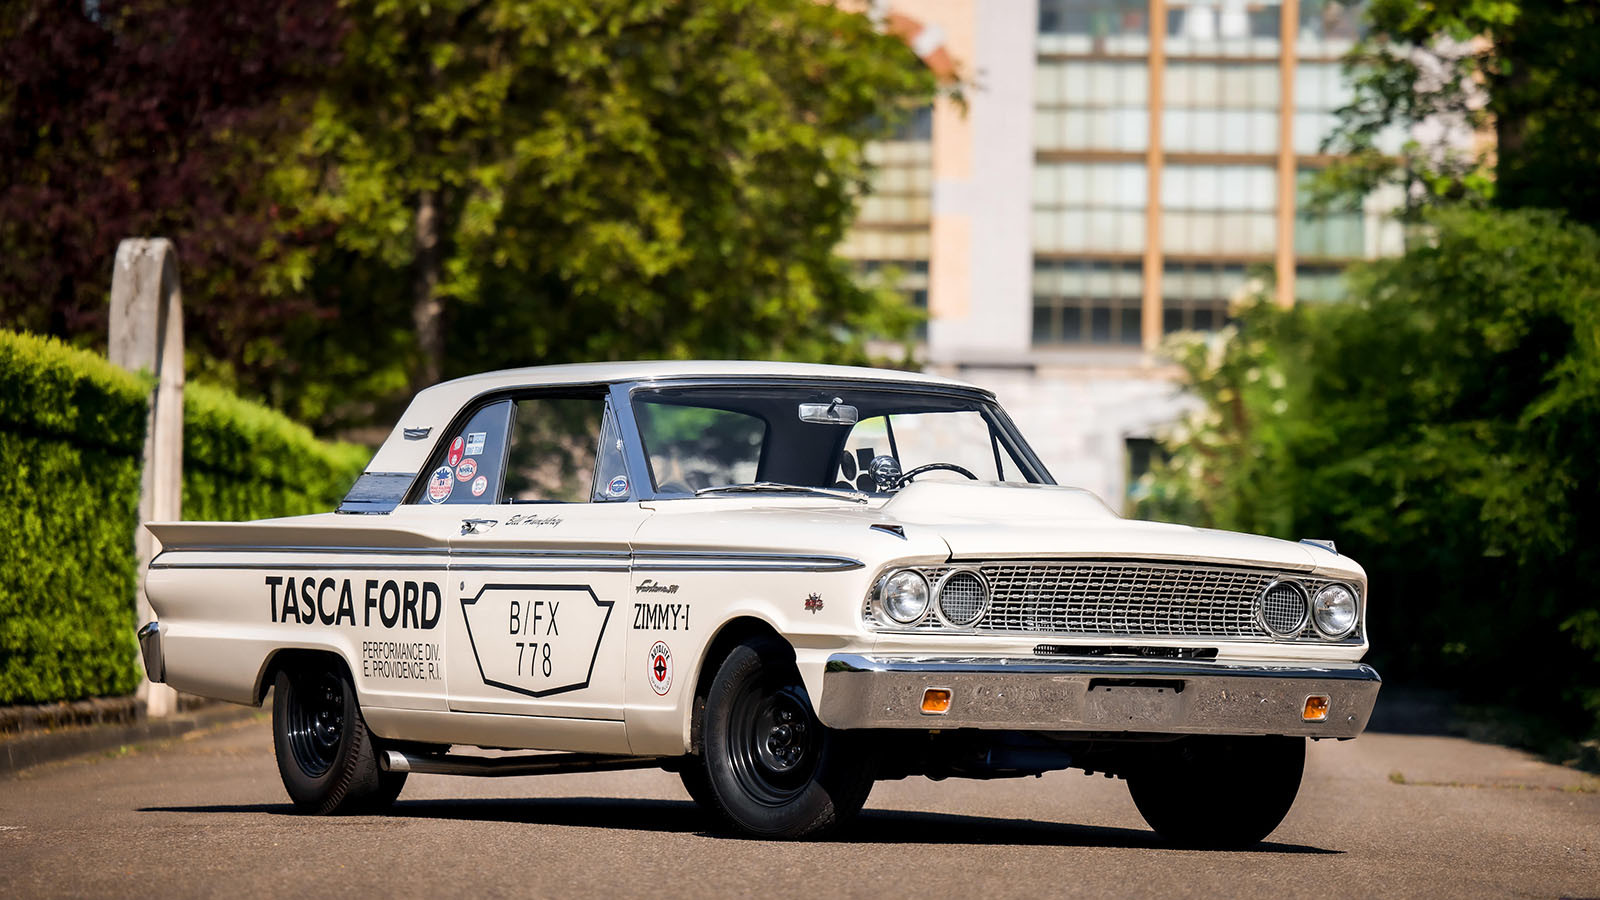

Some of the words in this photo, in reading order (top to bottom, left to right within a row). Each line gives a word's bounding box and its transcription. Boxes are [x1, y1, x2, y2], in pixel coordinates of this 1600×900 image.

[265, 576, 356, 626] TASCA
[364, 579, 442, 630] FORD
[509, 600, 560, 636] B/FX
[363, 641, 423, 661] PERFORMANCE
[425, 644, 441, 661] DIV.
[515, 642, 552, 678] 778
[363, 660, 372, 678] E.
[373, 660, 428, 683] PROVIDENCE,
[428, 663, 442, 681] R.I.
